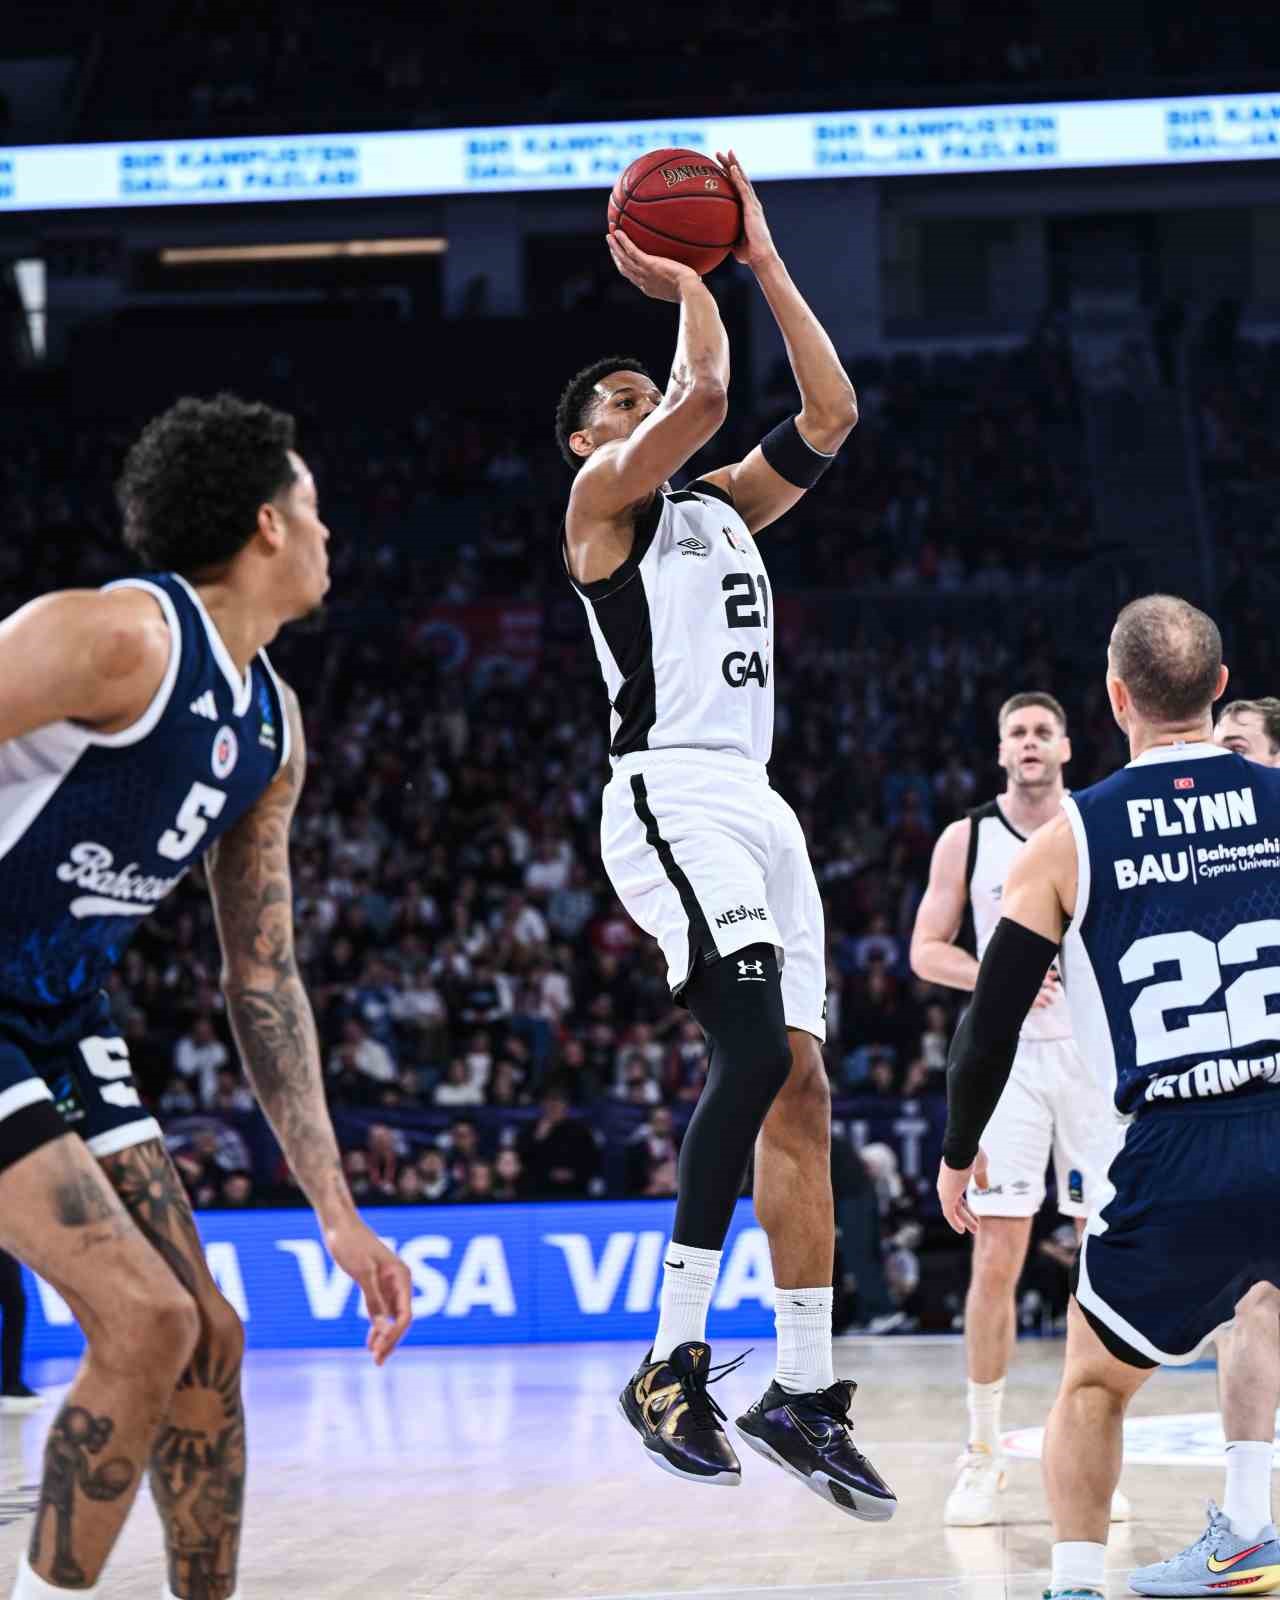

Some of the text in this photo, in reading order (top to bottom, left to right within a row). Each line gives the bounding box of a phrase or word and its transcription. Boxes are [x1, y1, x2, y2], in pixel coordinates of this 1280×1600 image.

[721, 650, 769, 689] GA
[157, 781, 227, 861] 5
[1126, 787, 1258, 838] FLYNN
[1113, 851, 1190, 891] BAU
[1198, 862, 1238, 878] Cyprus
[1118, 918, 1280, 1068] 22
[540, 1228, 777, 1316] VIA
